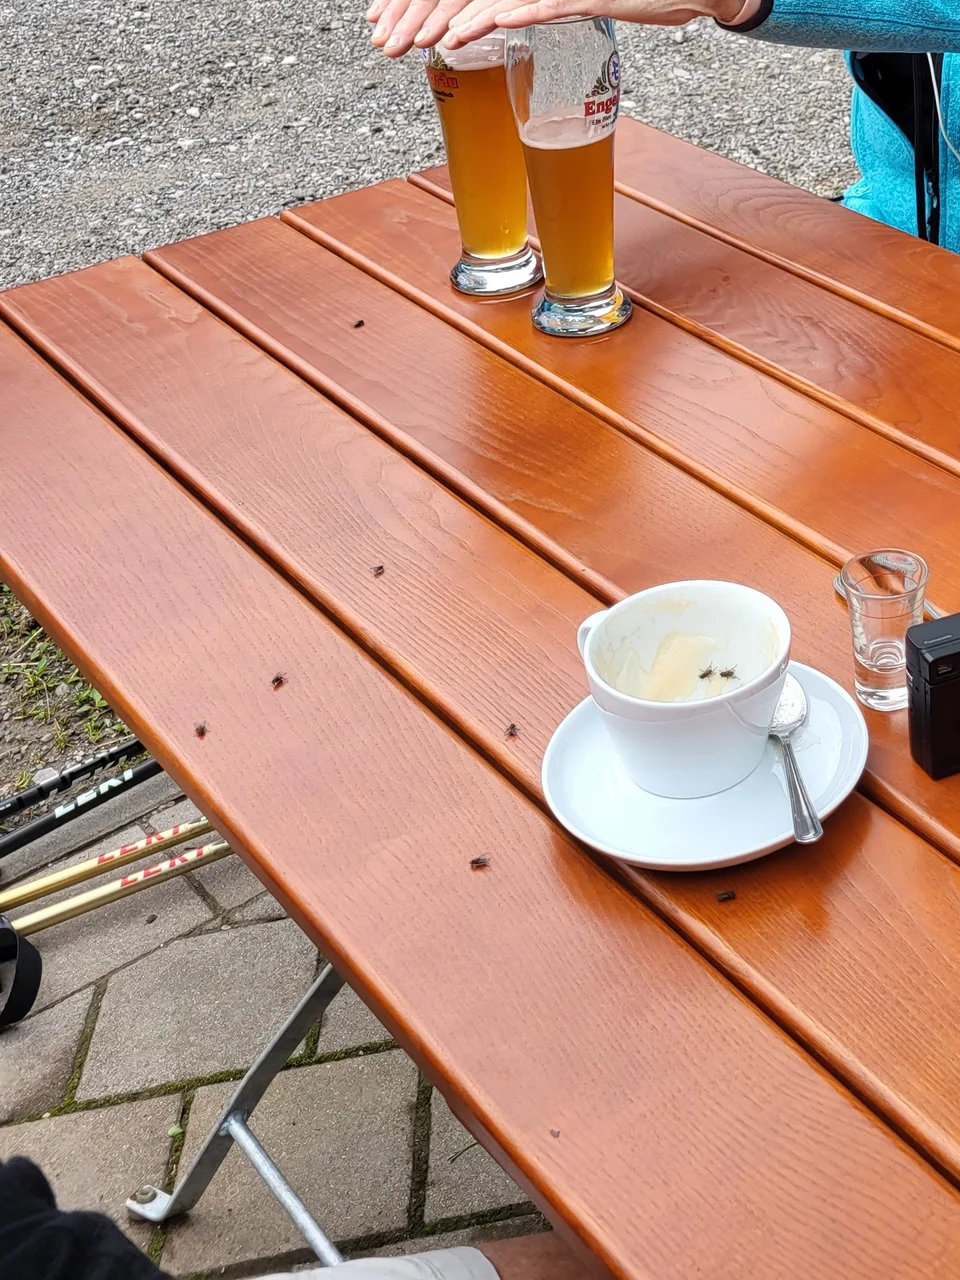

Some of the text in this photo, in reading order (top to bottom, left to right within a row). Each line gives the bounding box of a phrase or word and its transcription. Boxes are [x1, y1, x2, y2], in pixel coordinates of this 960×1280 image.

[55, 768, 133, 819] LEKI
[97, 825, 180, 864] LEKI
[120, 846, 204, 887] LEKI
